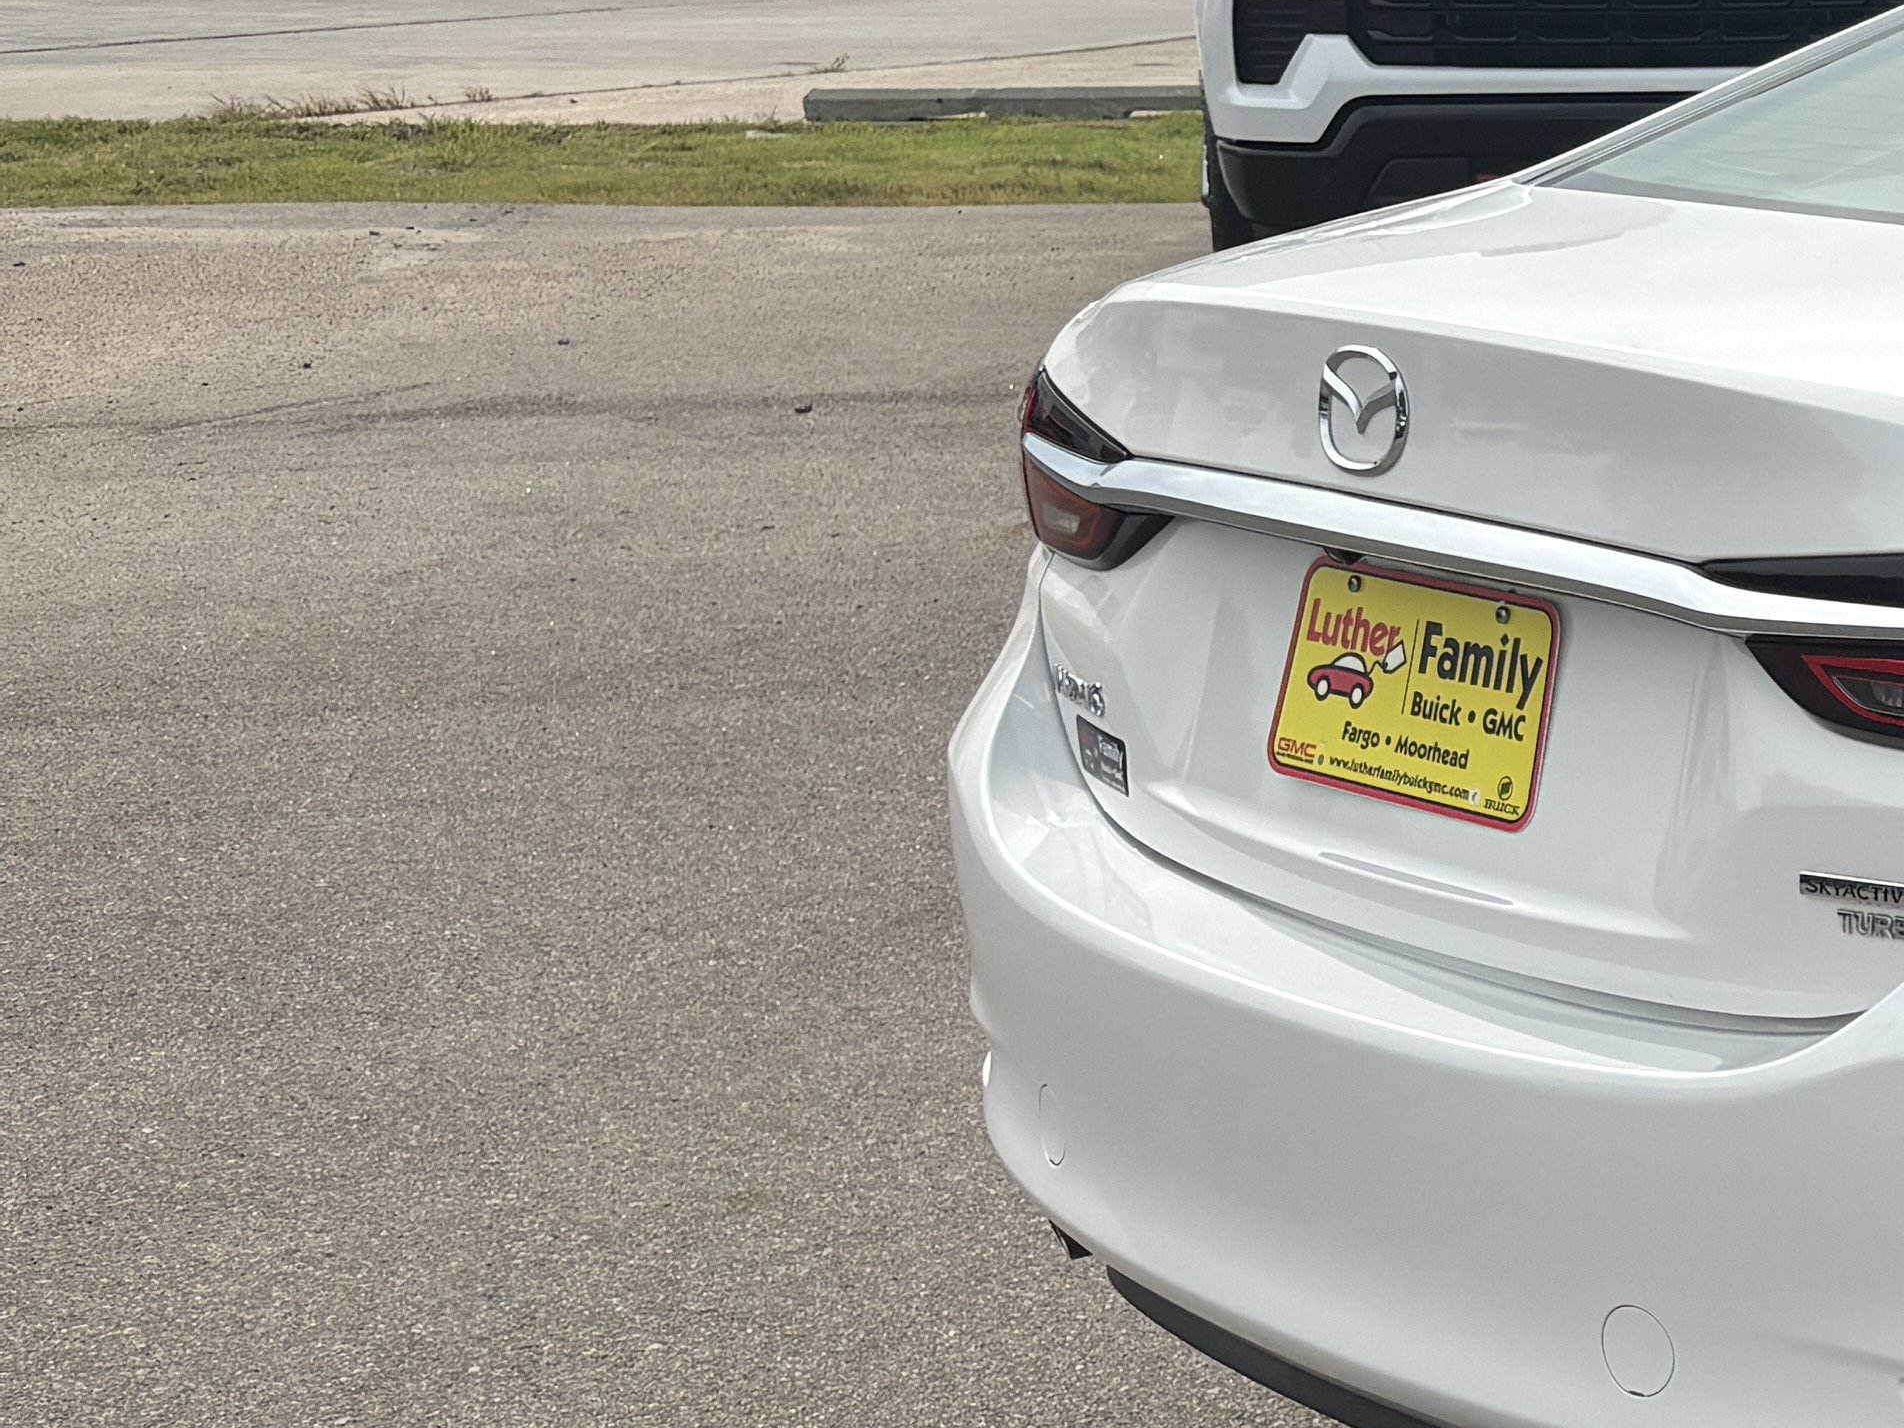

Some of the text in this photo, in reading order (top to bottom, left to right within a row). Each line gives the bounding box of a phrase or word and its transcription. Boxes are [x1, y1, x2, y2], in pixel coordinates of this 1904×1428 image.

[1305, 597, 1544, 711] Luther Family
[1410, 691, 1527, 742] Buick GMC
[1277, 736, 1318, 759] GMC
[1342, 720, 1470, 770] Fargo Moorhead
[1483, 798, 1521, 816] BUICK
